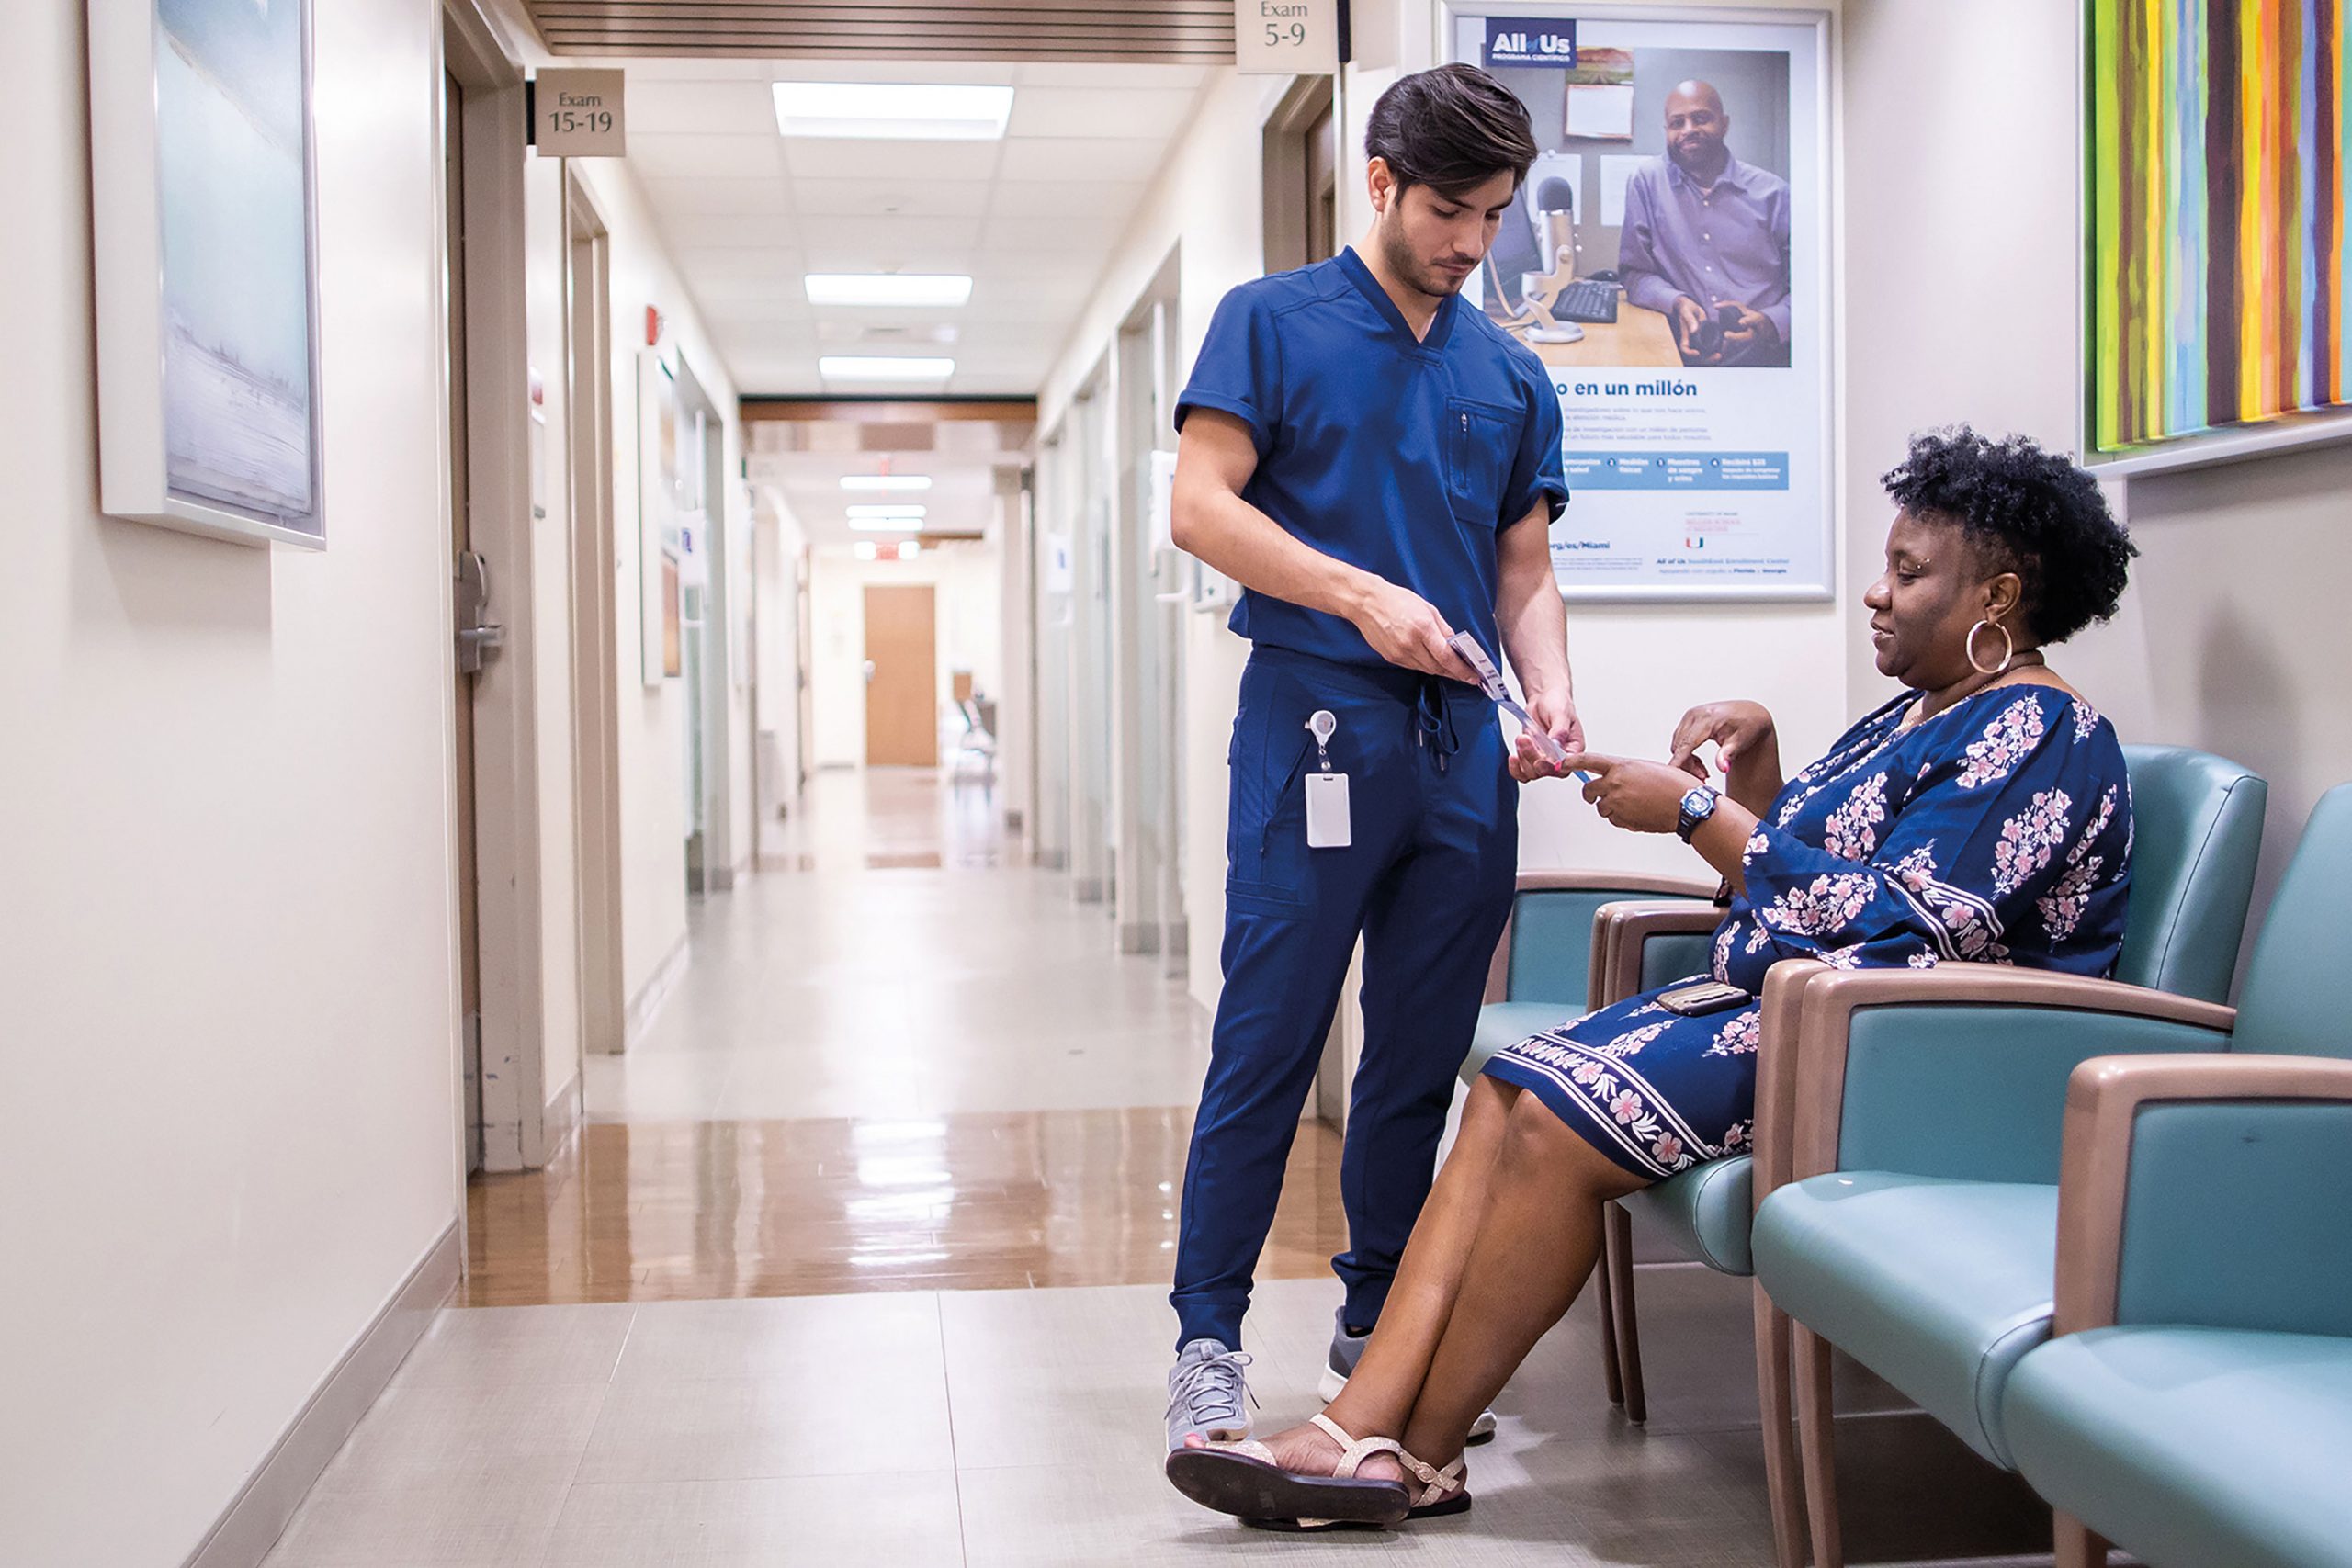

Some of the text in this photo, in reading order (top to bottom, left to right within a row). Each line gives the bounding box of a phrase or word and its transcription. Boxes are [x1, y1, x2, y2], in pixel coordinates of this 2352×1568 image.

[1261, 1, 1308, 17] Exam
[1264, 22, 1306, 47] 5-9
[1491, 32, 1527, 53] All
[1539, 34, 1571, 54] Us
[559, 92, 601, 107] Exam
[548, 111, 612, 133] 15-19
[1574, 382, 1599, 396] en
[1604, 382, 1630, 396] un
[1635, 378, 1698, 397] millón
